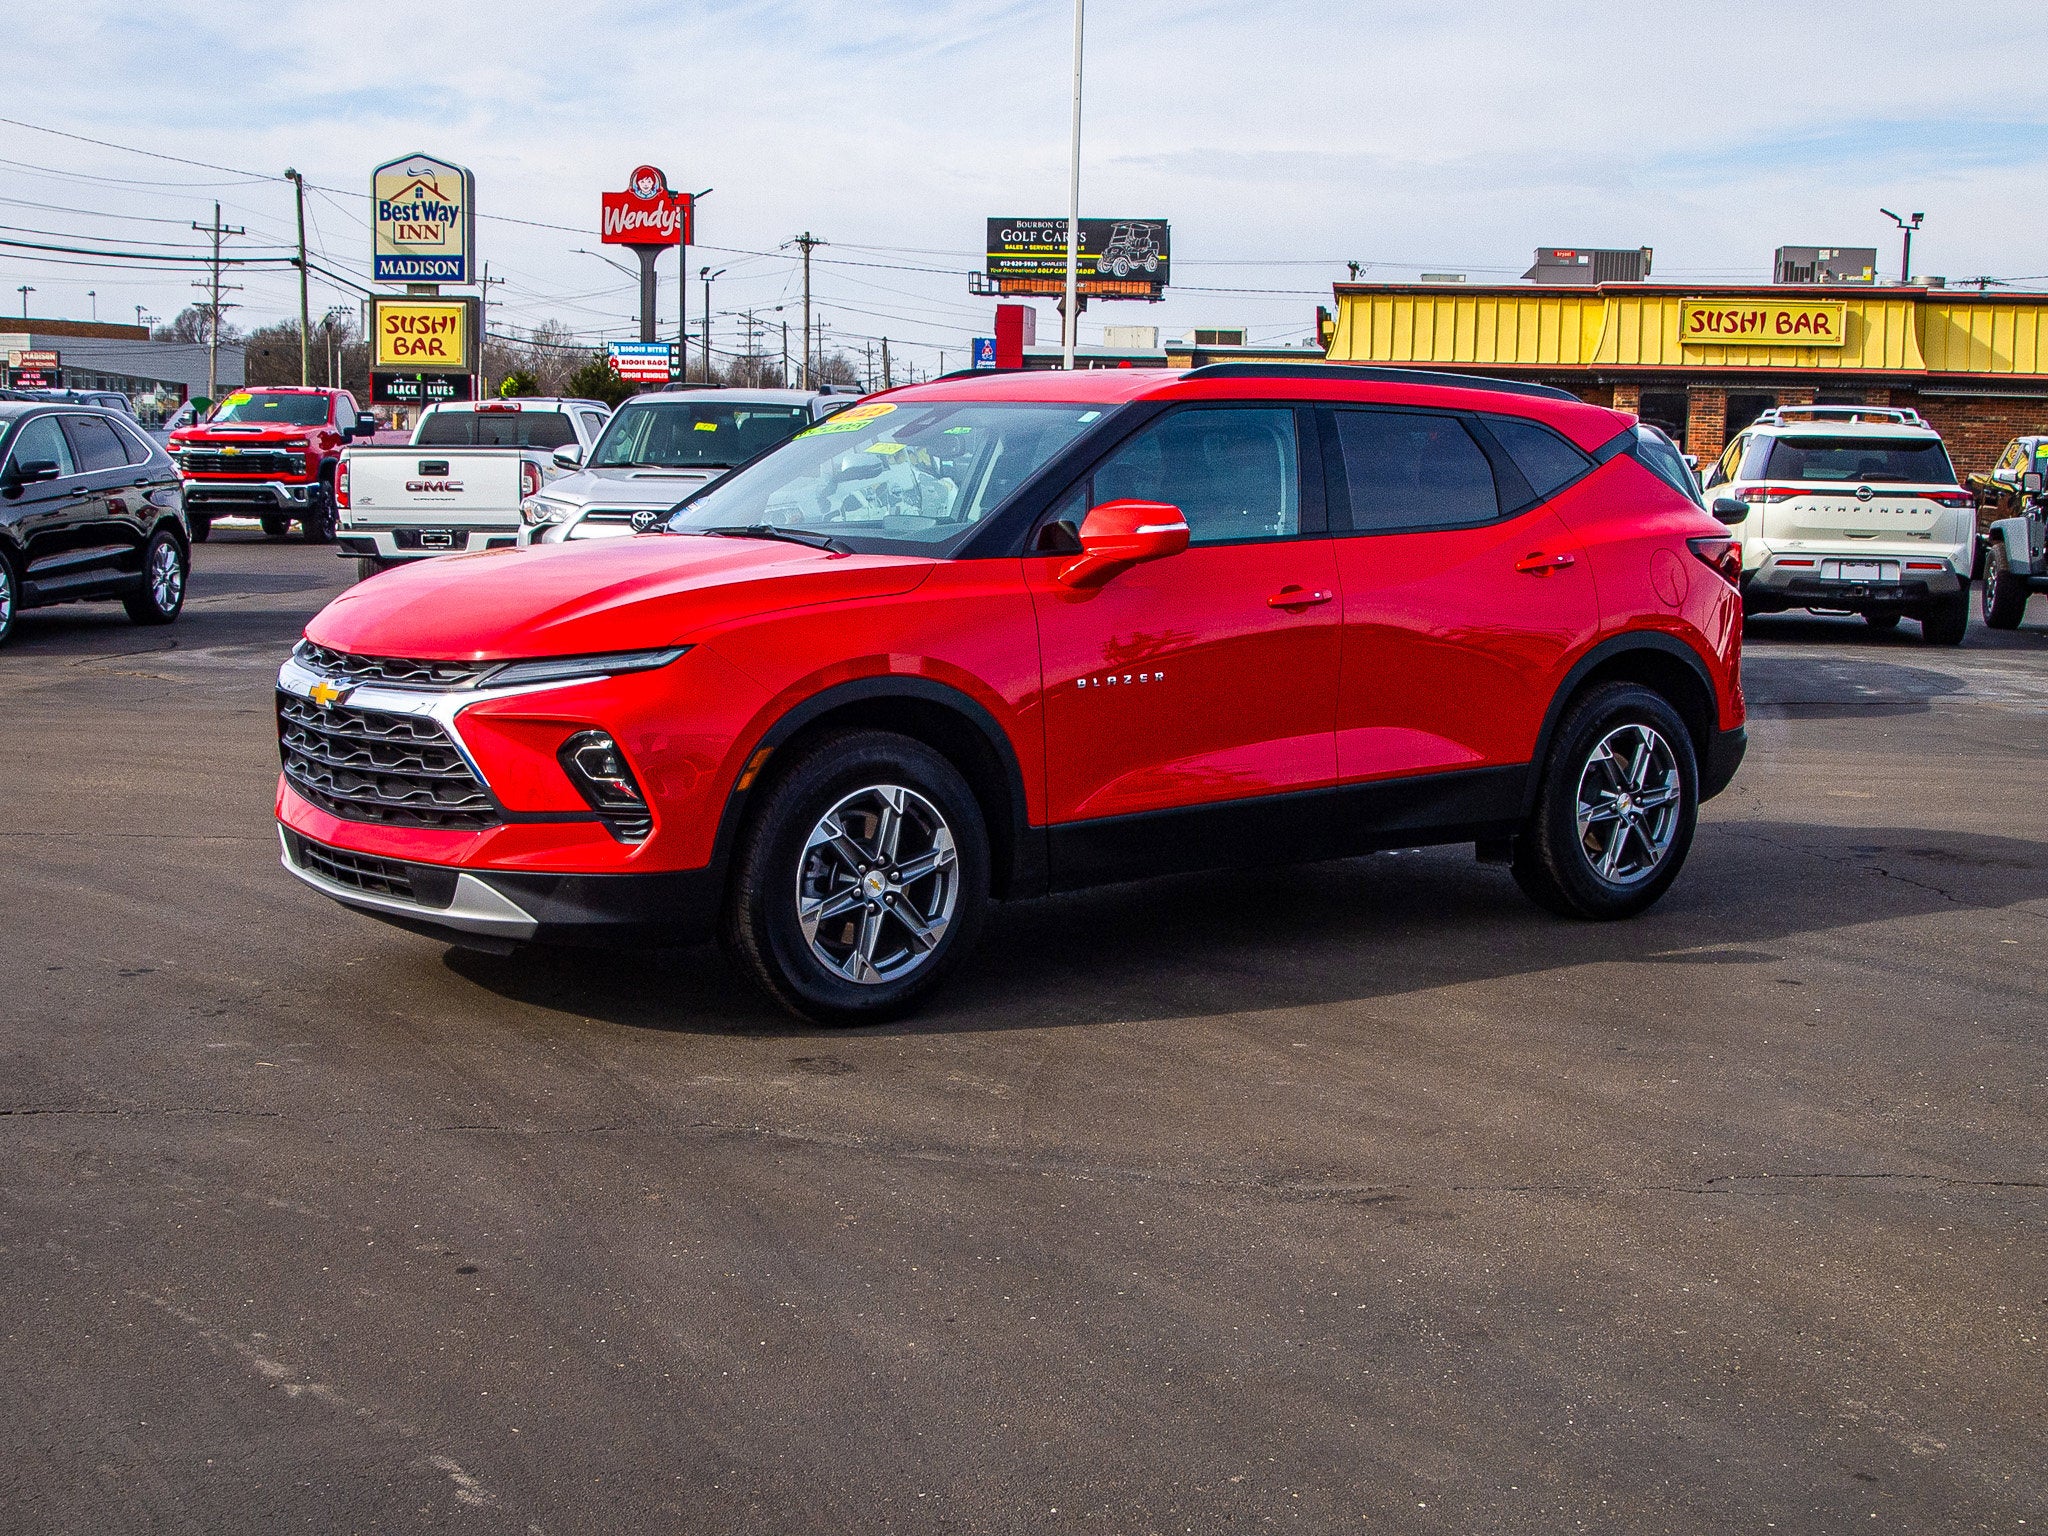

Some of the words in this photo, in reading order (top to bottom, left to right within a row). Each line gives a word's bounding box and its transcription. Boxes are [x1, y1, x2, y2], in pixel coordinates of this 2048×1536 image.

[380, 200, 419, 221] Best
[421, 200, 459, 228] Way
[604, 199, 687, 236] Wendy's
[398, 224, 440, 240] INN
[1016, 220, 1054, 228] BOURBON
[1056, 220, 1069, 229] CIT
[1000, 229, 1037, 242] GOLF
[1042, 229, 1087, 243] CARS
[379, 260, 459, 276] MADISON
[385, 315, 456, 334] SUSHI
[1690, 310, 1767, 334] SUSHI
[1775, 311, 1833, 335] BAR
[393, 336, 447, 356] BAR
[23, 352, 56, 360] MADISON
[387, 384, 418, 395] BLACK
[427, 385, 455, 395] LIVES
[405, 480, 464, 492] GMC
[1794, 505, 1933, 515] PATHFINDER
[1076, 671, 1165, 689] BLAZER
